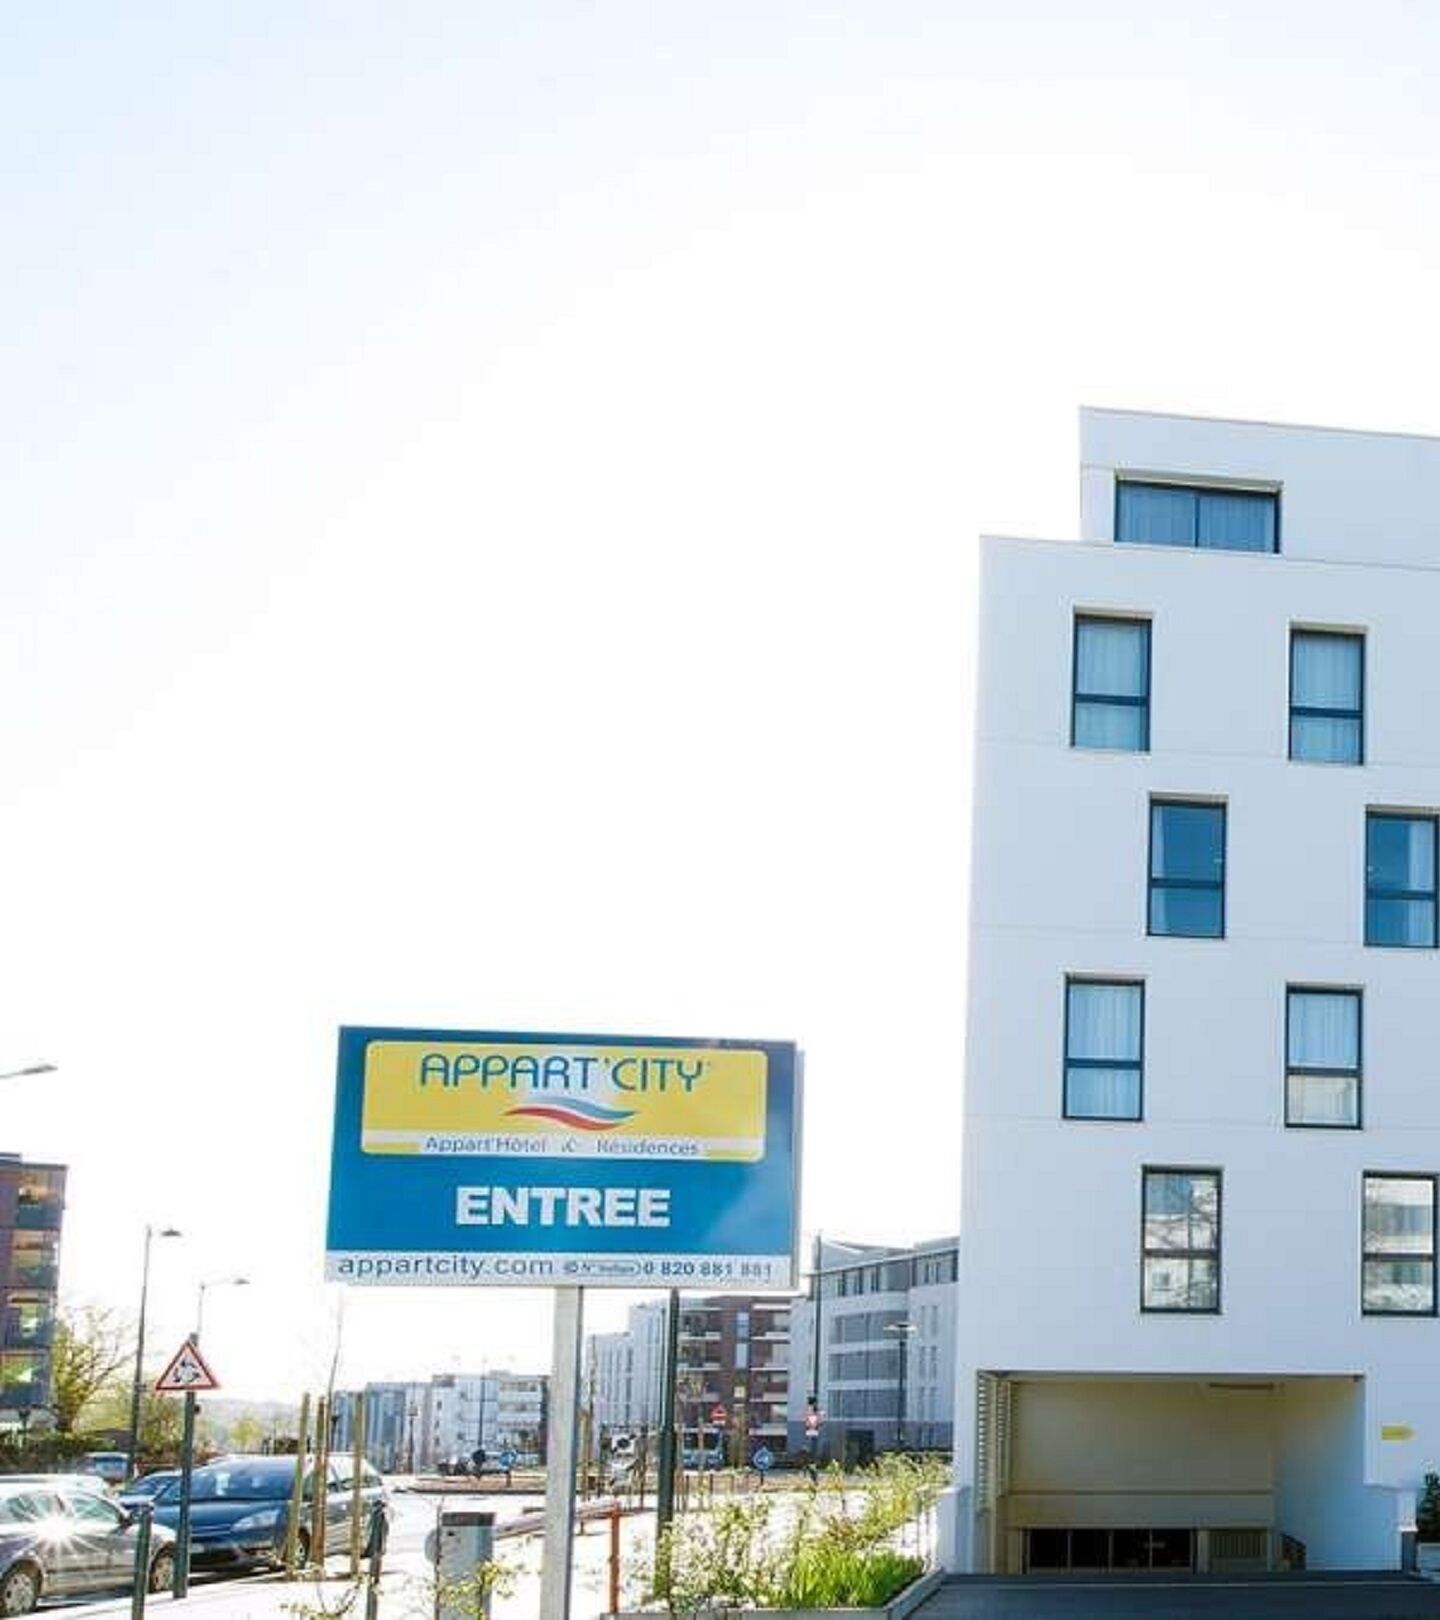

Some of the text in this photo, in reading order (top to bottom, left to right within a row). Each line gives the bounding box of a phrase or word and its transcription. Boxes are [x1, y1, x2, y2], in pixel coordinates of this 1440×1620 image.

[455, 1186, 671, 1227] ENTREE
[338, 1255, 553, 1279] appartcity.com
[661, 1260, 695, 1275] 820
